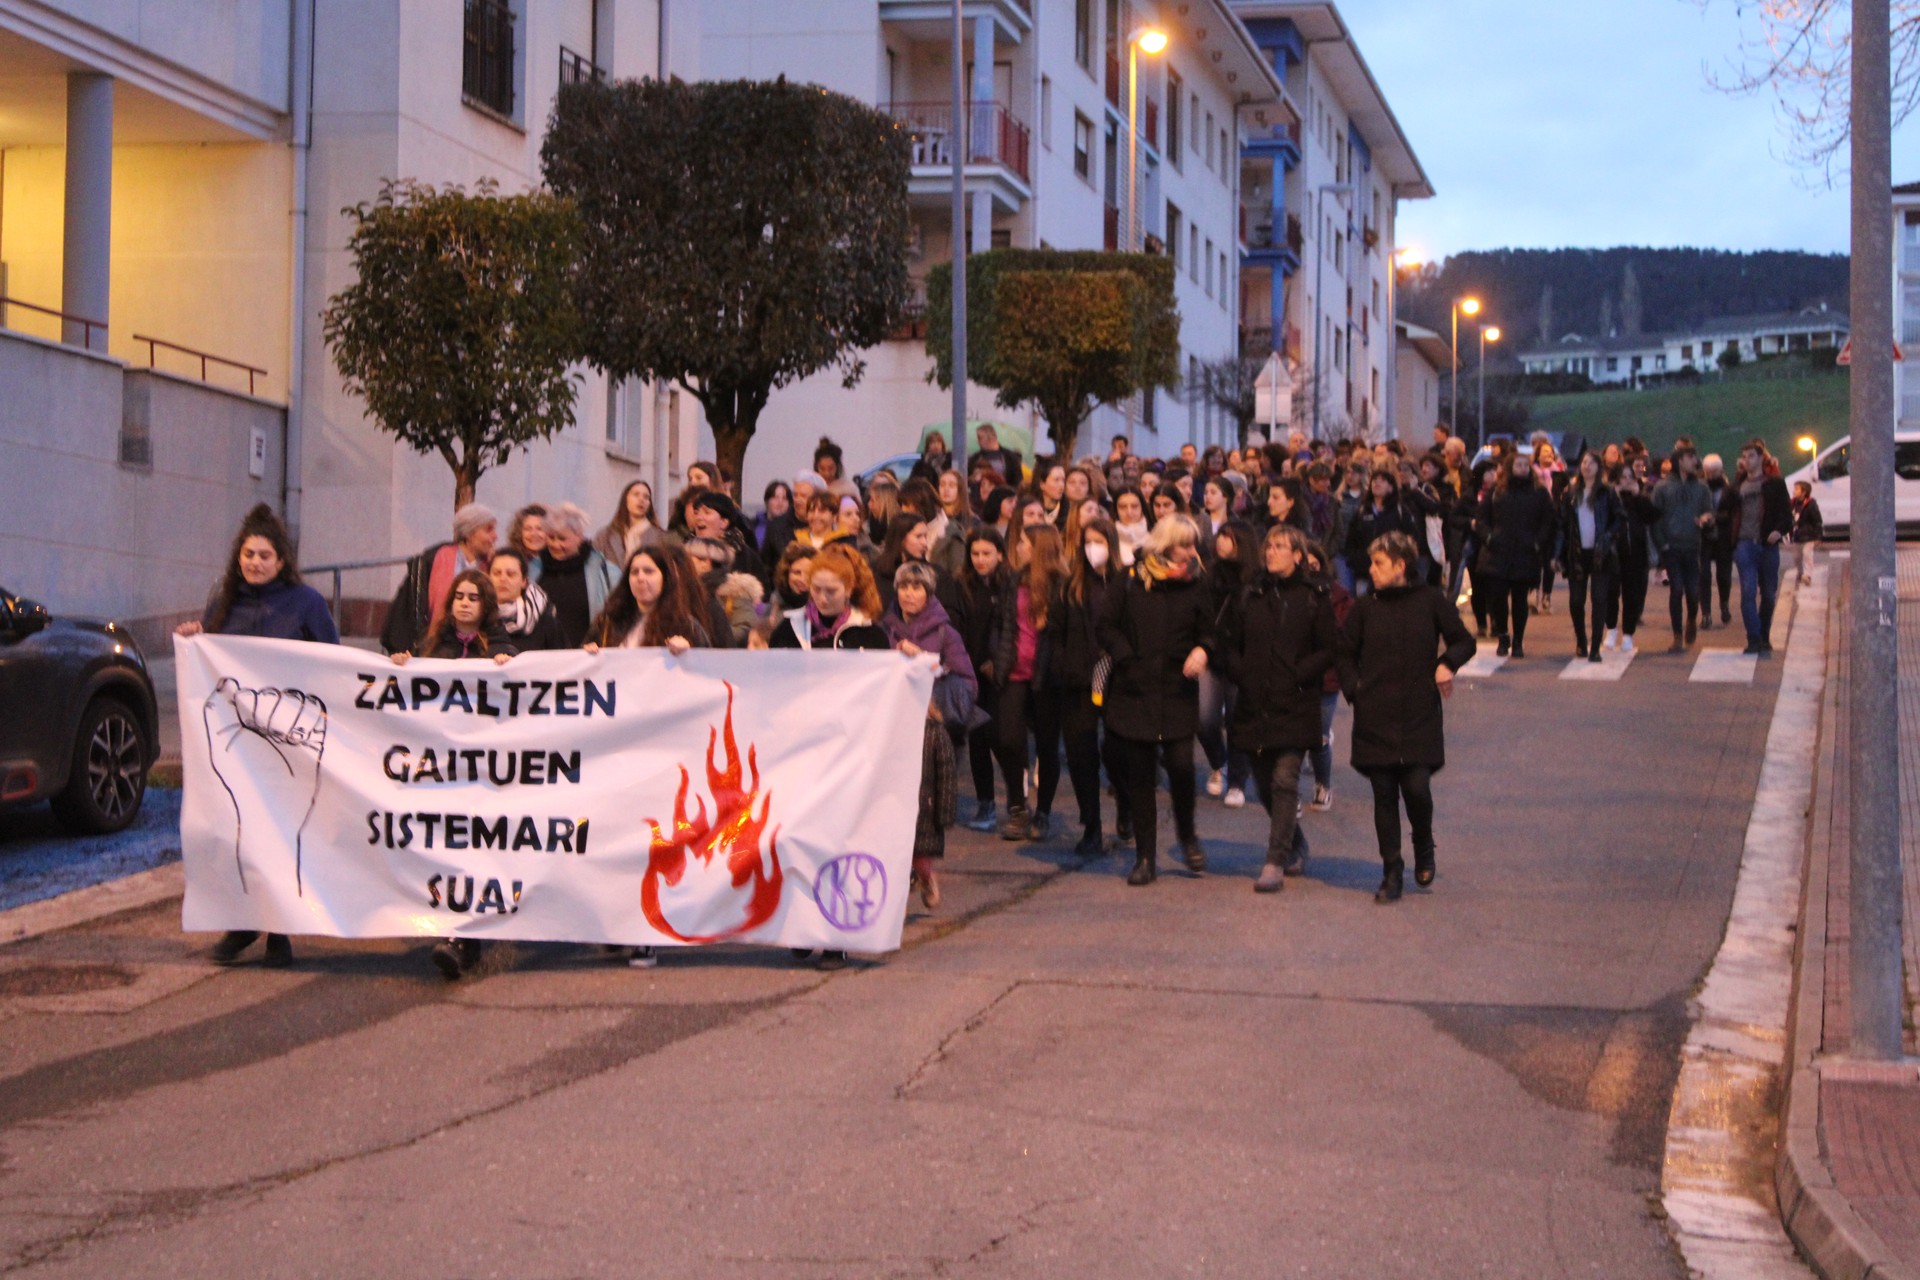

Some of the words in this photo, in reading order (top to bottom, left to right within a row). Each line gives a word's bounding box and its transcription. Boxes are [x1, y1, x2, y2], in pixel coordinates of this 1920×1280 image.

[354, 673, 616, 718] ZAPALTZEN
[383, 744, 581, 787] GAITUEN
[367, 809, 590, 855] SISTEMARI
[427, 872, 523, 914] SUA!
